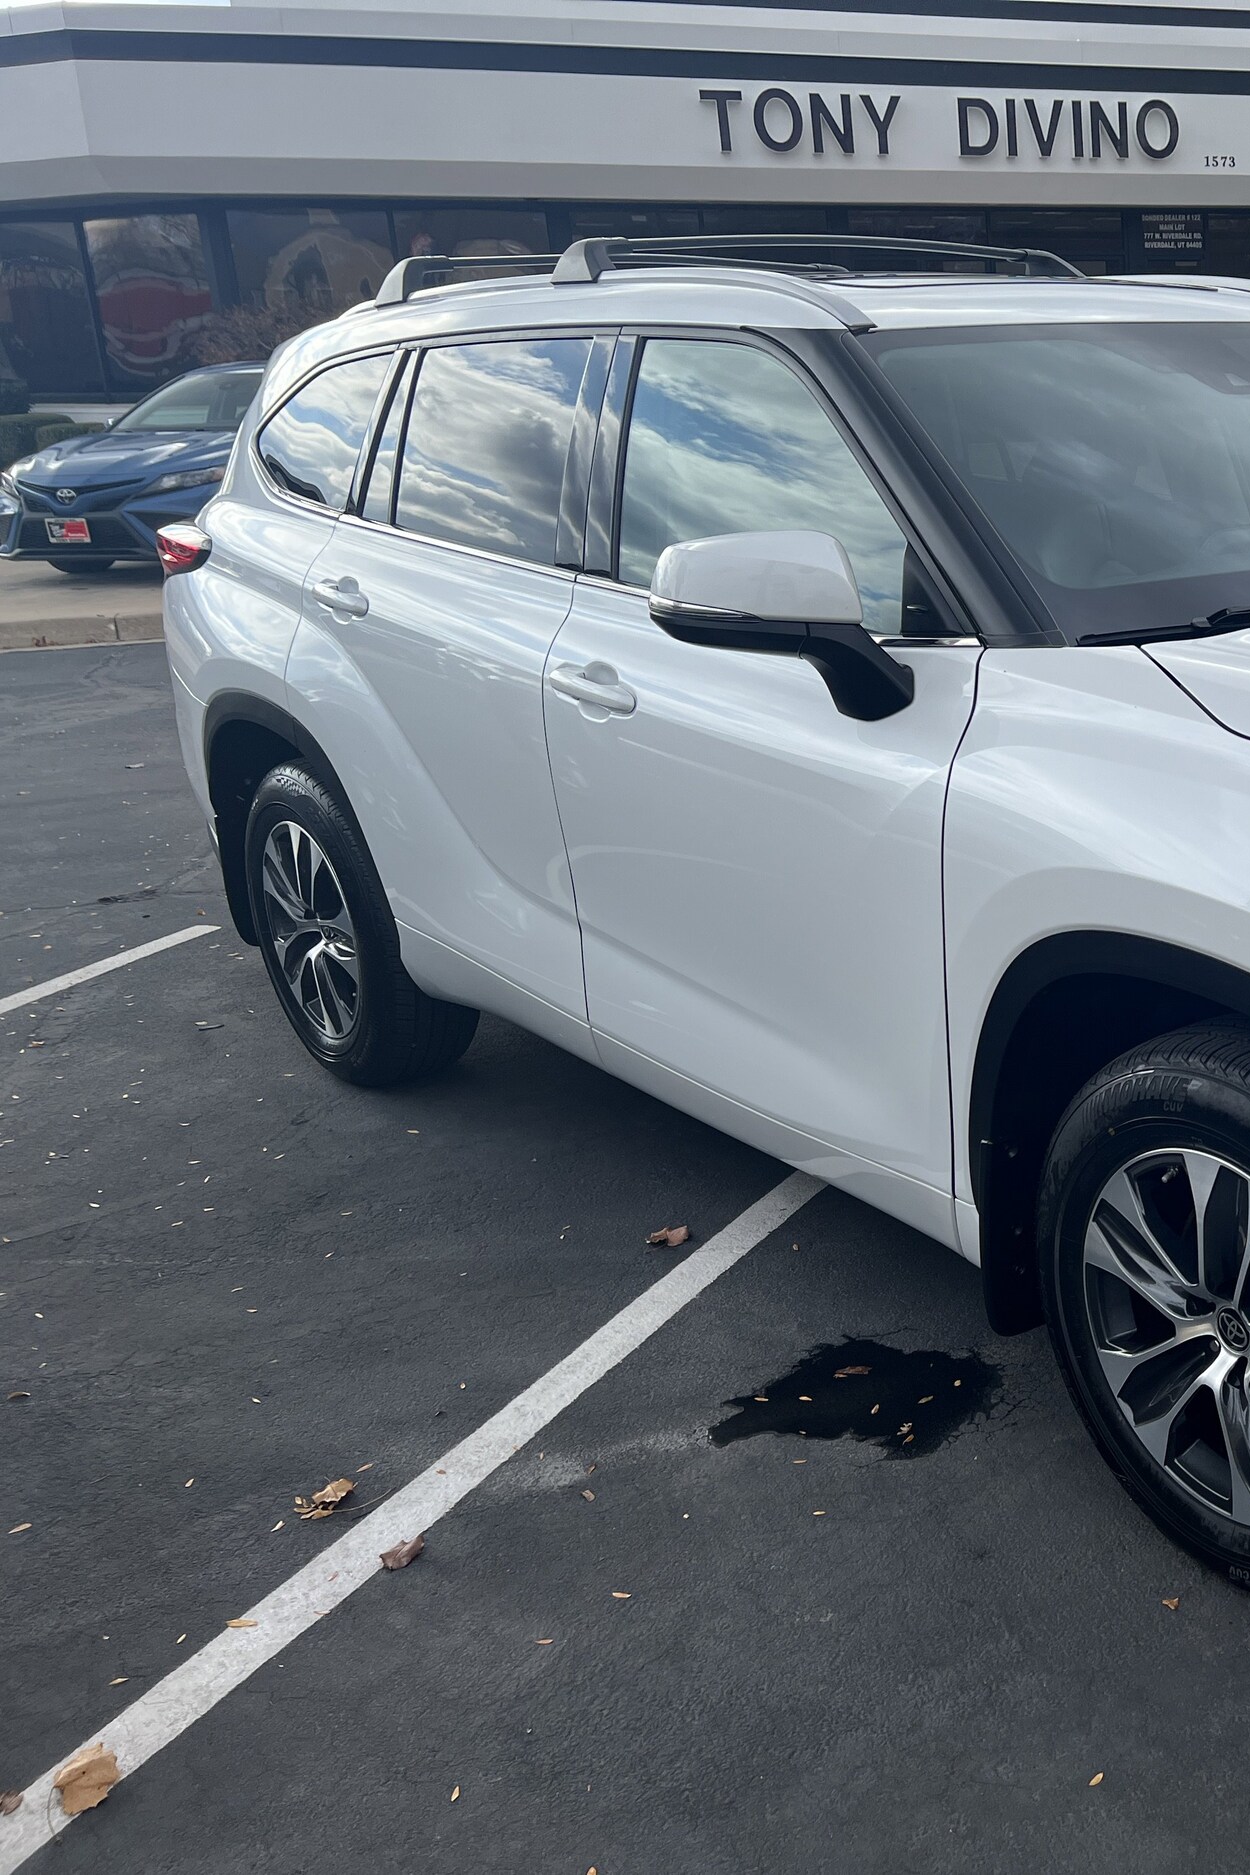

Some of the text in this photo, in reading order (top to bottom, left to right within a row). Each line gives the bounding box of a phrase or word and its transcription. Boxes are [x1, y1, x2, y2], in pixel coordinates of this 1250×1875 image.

[699, 88, 1180, 159] TONY DIVINO
[1204, 155, 1236, 168] 1573
[1144, 241, 1177, 249] RIVERDALE,
[1102, 1075, 1191, 1110] MOHAVE
[1163, 1101, 1184, 1113] CUV
